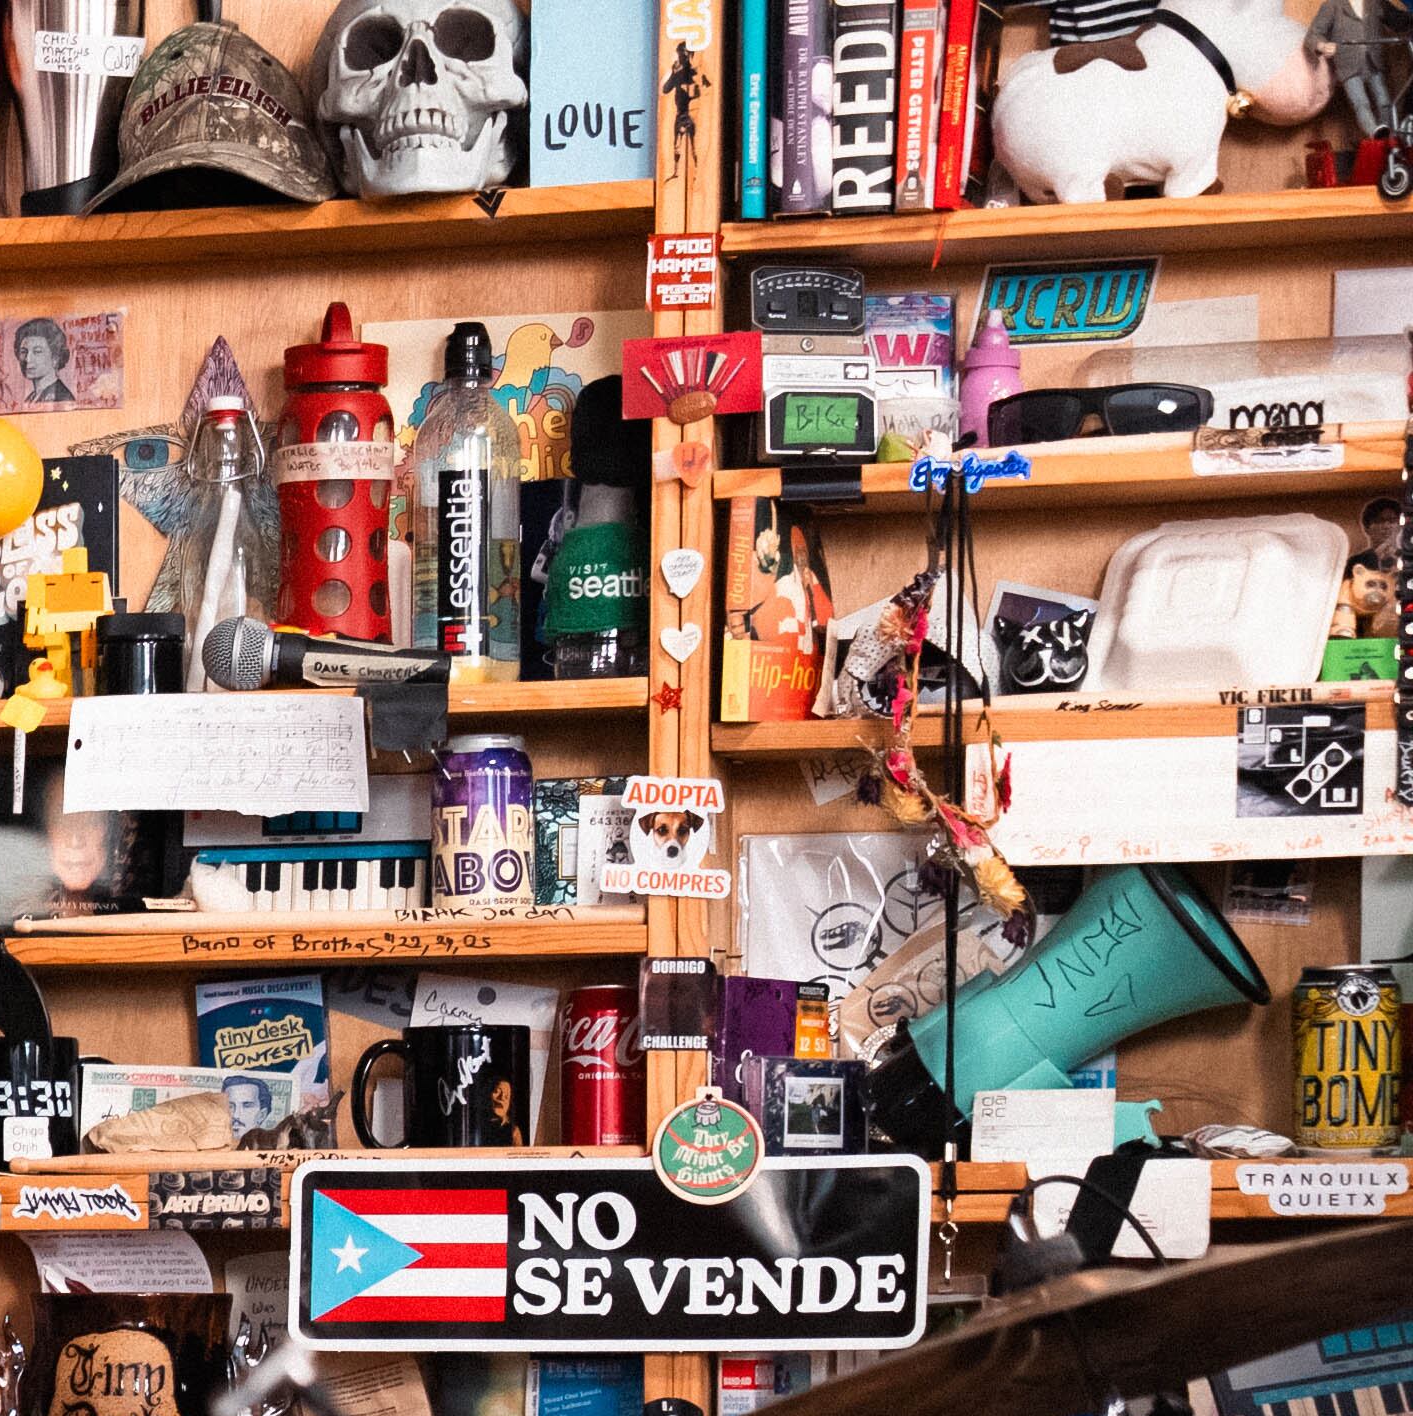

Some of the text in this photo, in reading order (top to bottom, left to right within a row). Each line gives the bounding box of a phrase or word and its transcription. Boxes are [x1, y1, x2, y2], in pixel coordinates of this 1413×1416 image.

[909, 35, 926, 90] PETER
[749, 73, 762, 98] Eric
[796, 70, 808, 110] RALPH
[140, 75, 293, 128] BILLIE EILISH
[544, 102, 647, 151] LOUIE
[786, 118, 795, 145] DEAN
[795, 112, 808, 166] STANLEY
[905, 93, 924, 172] GETHERS
[989, 268, 1148, 334] KCRW
[445, 478, 476, 609] essentia
[2, 555, 34, 581] OF
[568, 563, 609, 574] VISIT
[730, 536, 752, 604] Hip-hop
[313, 661, 351, 676] DAVE
[750, 655, 823, 698] Hip-ho
[1218, 686, 1314, 705] VIC FIRTH
[627, 782, 719, 808] ADOPTA
[604, 870, 726, 895] NO COMPRES
[651, 960, 706, 974] DORRIGO
[241, 982, 265, 994] MUSIC
[219, 1018, 302, 1048] tiny desk
[643, 1035, 708, 1049] CHALLENGE
[1309, 1019, 1399, 1072] TINY
[221, 1041, 307, 1068] CONTEST
[577, 1072, 627, 1080] ORIGINAL
[692, 1129, 731, 1149] They
[675, 1145, 725, 1170] Might
[676, 1165, 736, 1185] Giants
[1244, 1172, 1399, 1186] TRANQUILX
[161, 1192, 271, 1214] ART PRIMO
[1278, 1193, 1376, 1208] QUIETX
[517, 1191, 637, 1251] NO
[513, 1253, 907, 1317] SE VENDE
[63, 1341, 166, 1407] Tiny
